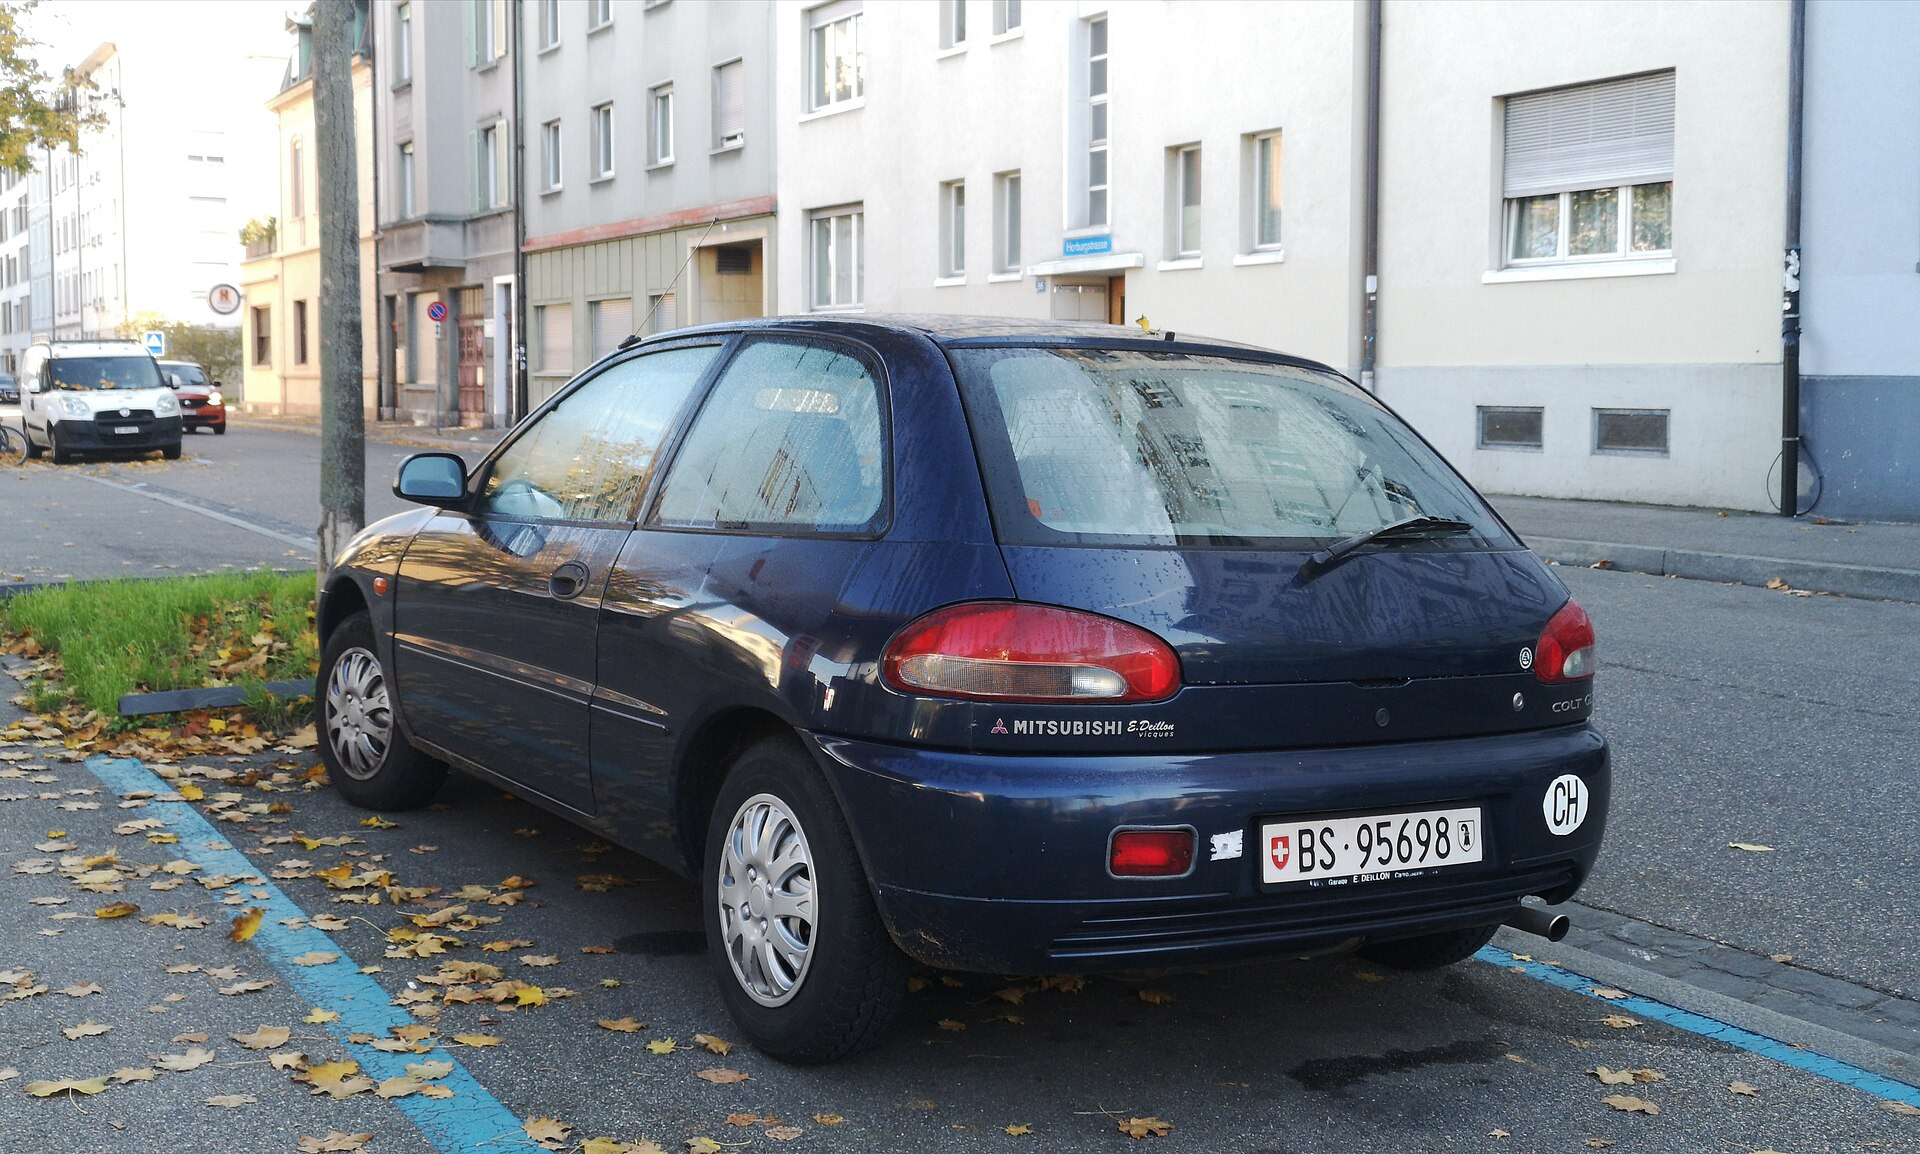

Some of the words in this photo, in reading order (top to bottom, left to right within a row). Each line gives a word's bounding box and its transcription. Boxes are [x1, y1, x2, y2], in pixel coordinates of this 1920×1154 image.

[1065, 240, 1108, 253] Horburgstrasse
[1552, 698, 1582, 713] COLT
[1013, 720, 1122, 735] MITSUBISHI
[1553, 779, 1579, 827] CH
